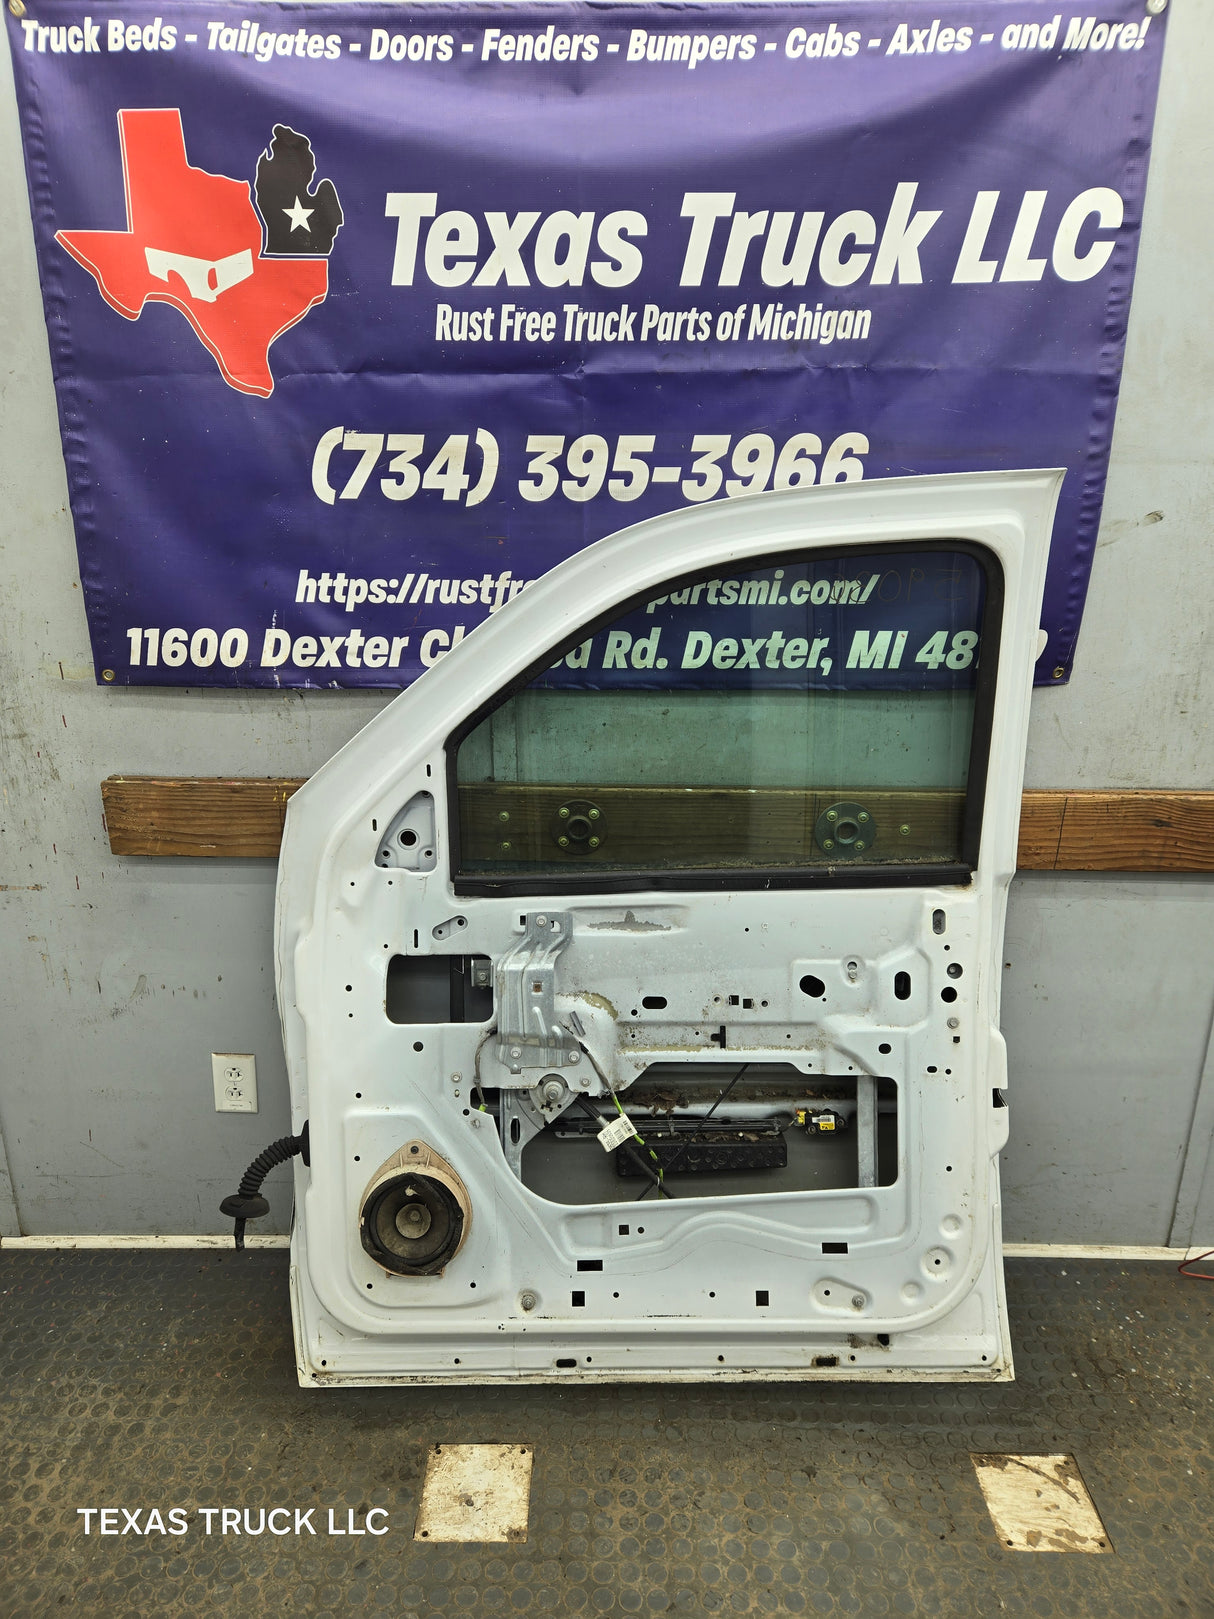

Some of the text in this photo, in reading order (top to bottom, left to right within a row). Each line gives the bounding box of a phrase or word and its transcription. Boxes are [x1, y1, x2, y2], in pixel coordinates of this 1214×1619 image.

[21, 18, 99, 54] Truck
[107, 18, 178, 52] Beds
[207, 20, 341, 62] Tailgates
[369, 29, 454, 61] Doors
[481, 26, 599, 61] Fenders
[627, 29, 756, 69] Bumpers
[785, 23, 860, 60] Cabs
[886, 22, 973, 56] Axles
[1001, 15, 1060, 51] and
[1063, 16, 1151, 51] More!
[385, 182, 1124, 287] Texas Truck LLC
[436, 303, 871, 345] Rust Free Truck Parts of Michigan
[312, 426, 869, 507] (734) 395-3966
[127, 628, 248, 667] 11600
[260, 629, 409, 667] Dexter
[602, 627, 668, 669] Rd.
[681, 630, 832, 675] Dexter,
[846, 631, 908, 669] MI
